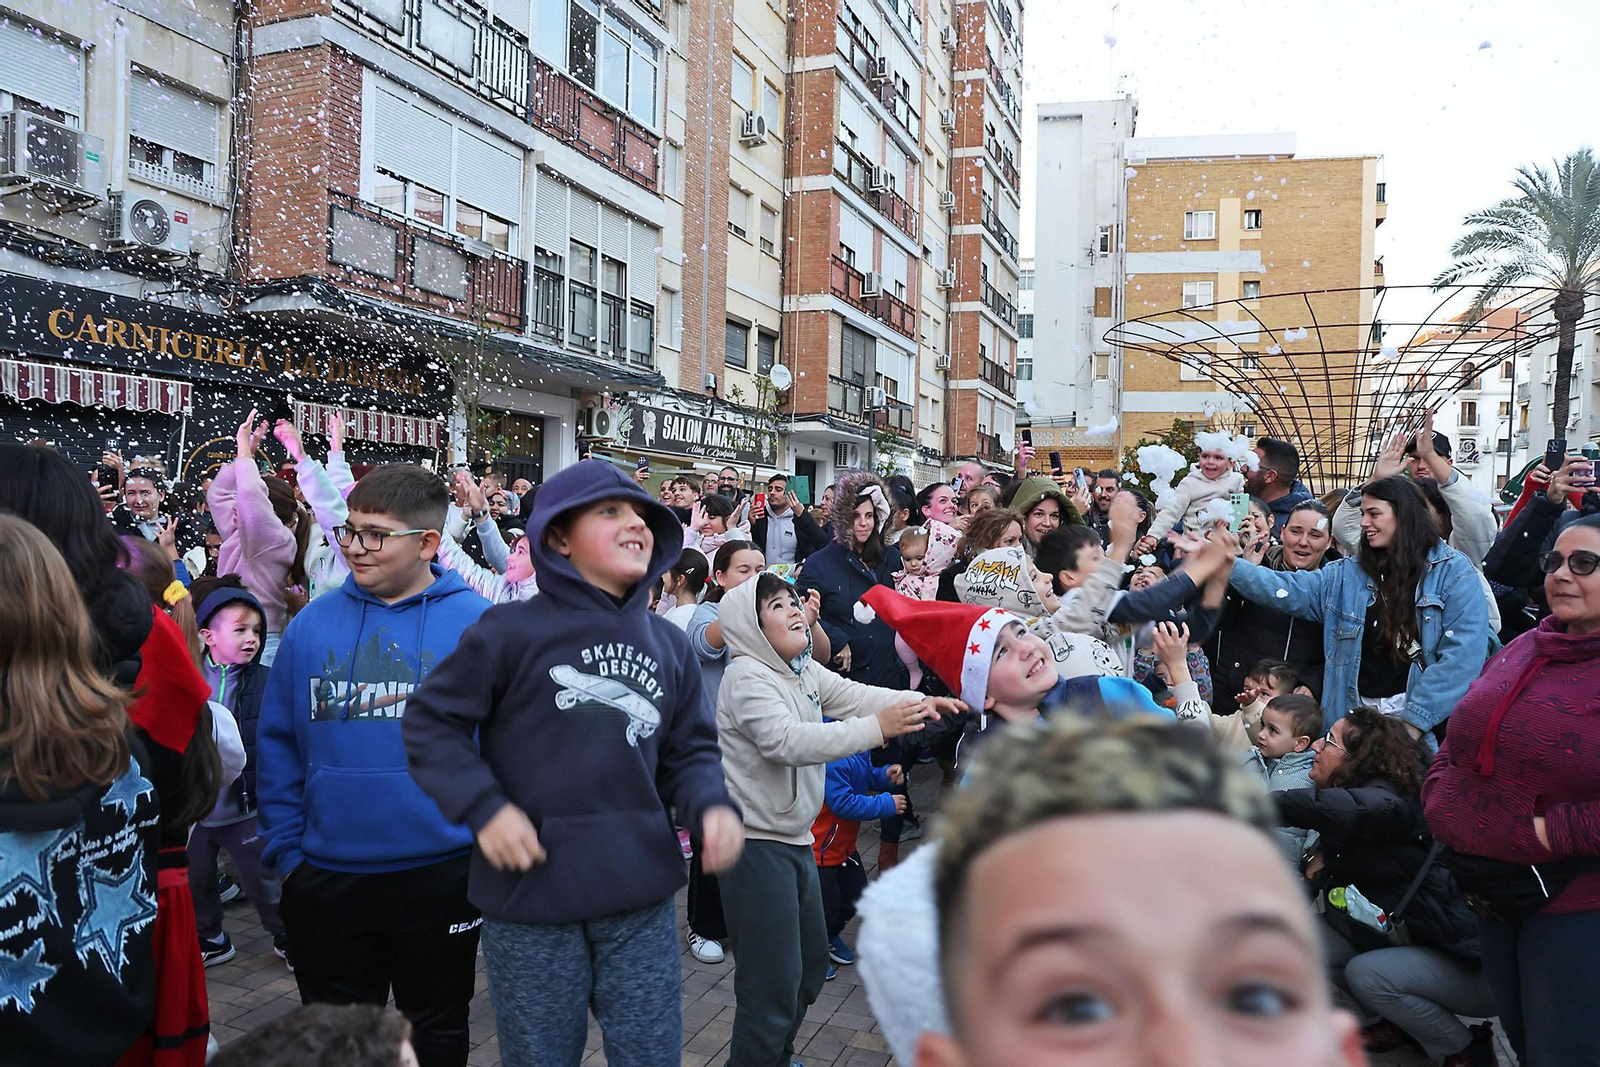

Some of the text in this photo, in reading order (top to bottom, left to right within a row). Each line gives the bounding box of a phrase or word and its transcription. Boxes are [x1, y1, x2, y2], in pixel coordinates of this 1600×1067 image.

[48, 308, 269, 371] CARNICERÍA
[283, 348, 320, 379] LA
[662, 414, 703, 445] SALON
[580, 643, 658, 673] SKATE AND
[598, 659, 664, 700] DESTROY
